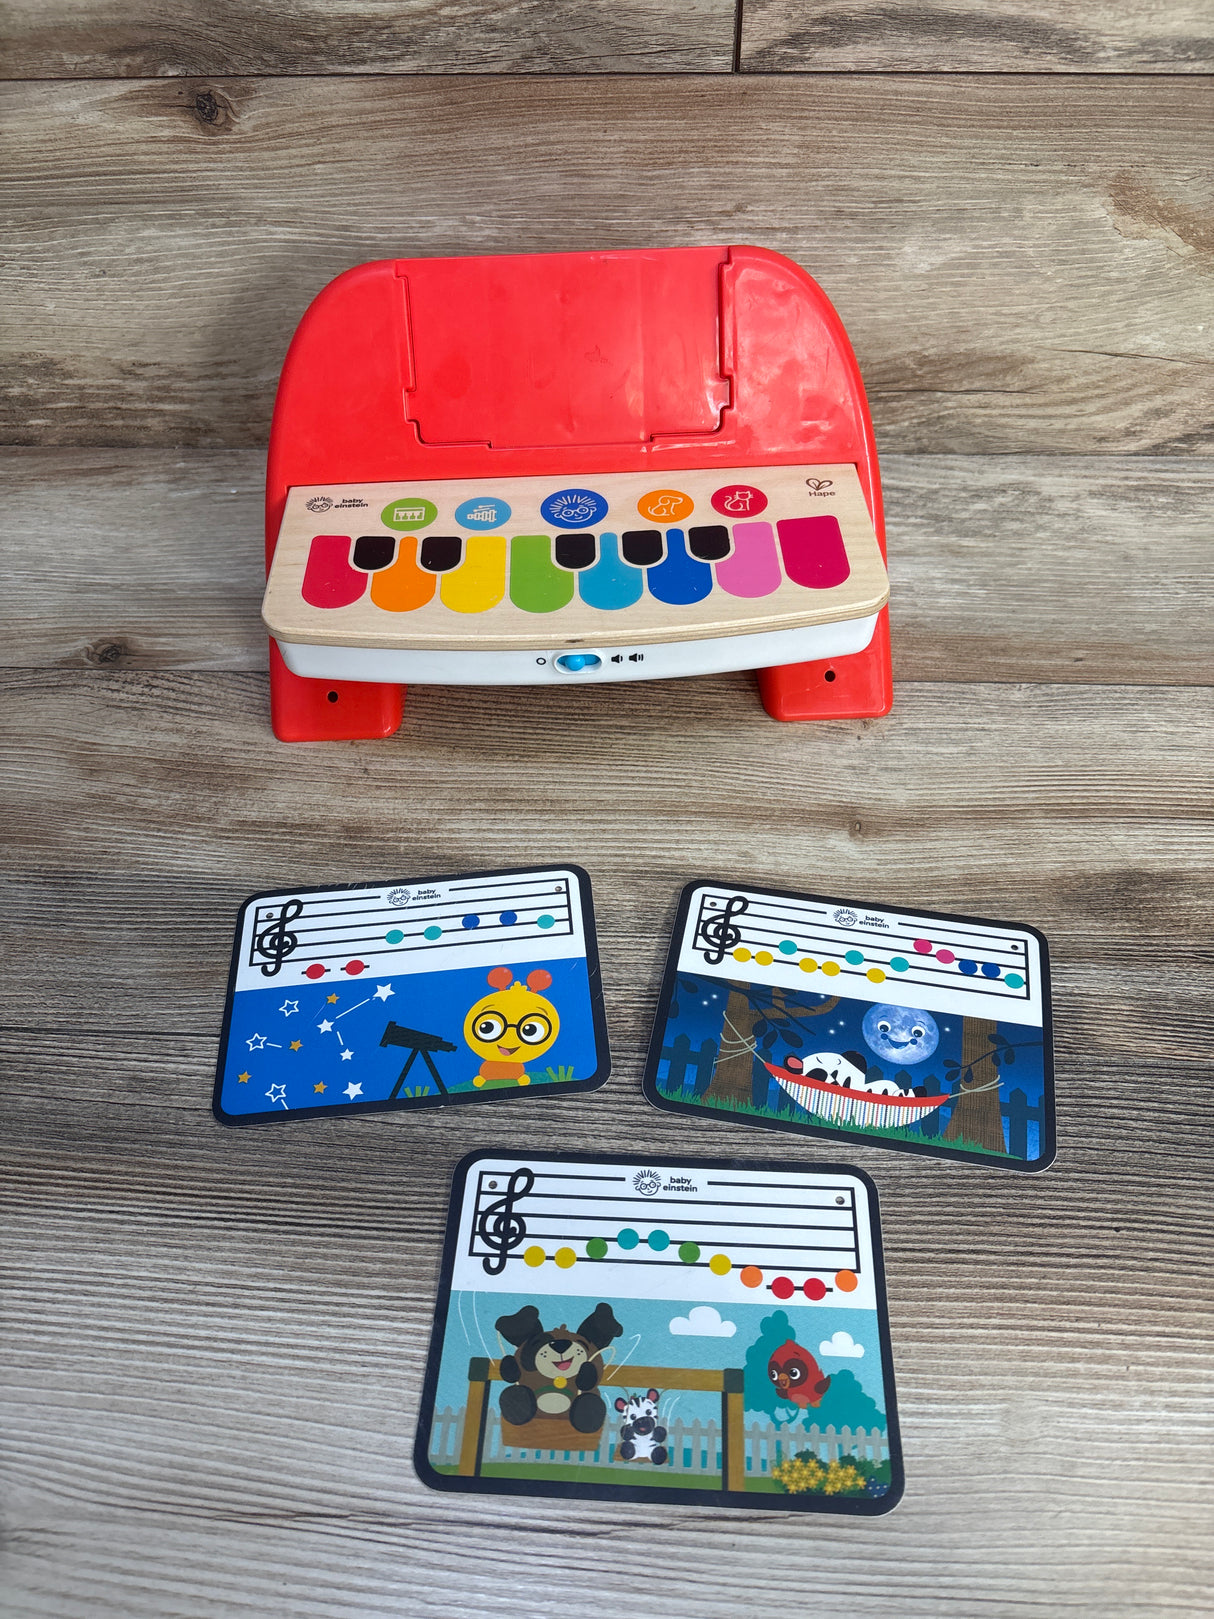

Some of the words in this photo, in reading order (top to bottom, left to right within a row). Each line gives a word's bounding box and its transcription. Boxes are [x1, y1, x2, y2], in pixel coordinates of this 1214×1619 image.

[808, 490, 836, 498] Hape
[411, 893, 441, 901] einstein
[865, 914, 884, 923] baby
[858, 919, 890, 929] einstein
[669, 1176, 692, 1185] baby
[662, 1184, 698, 1192] einstein
